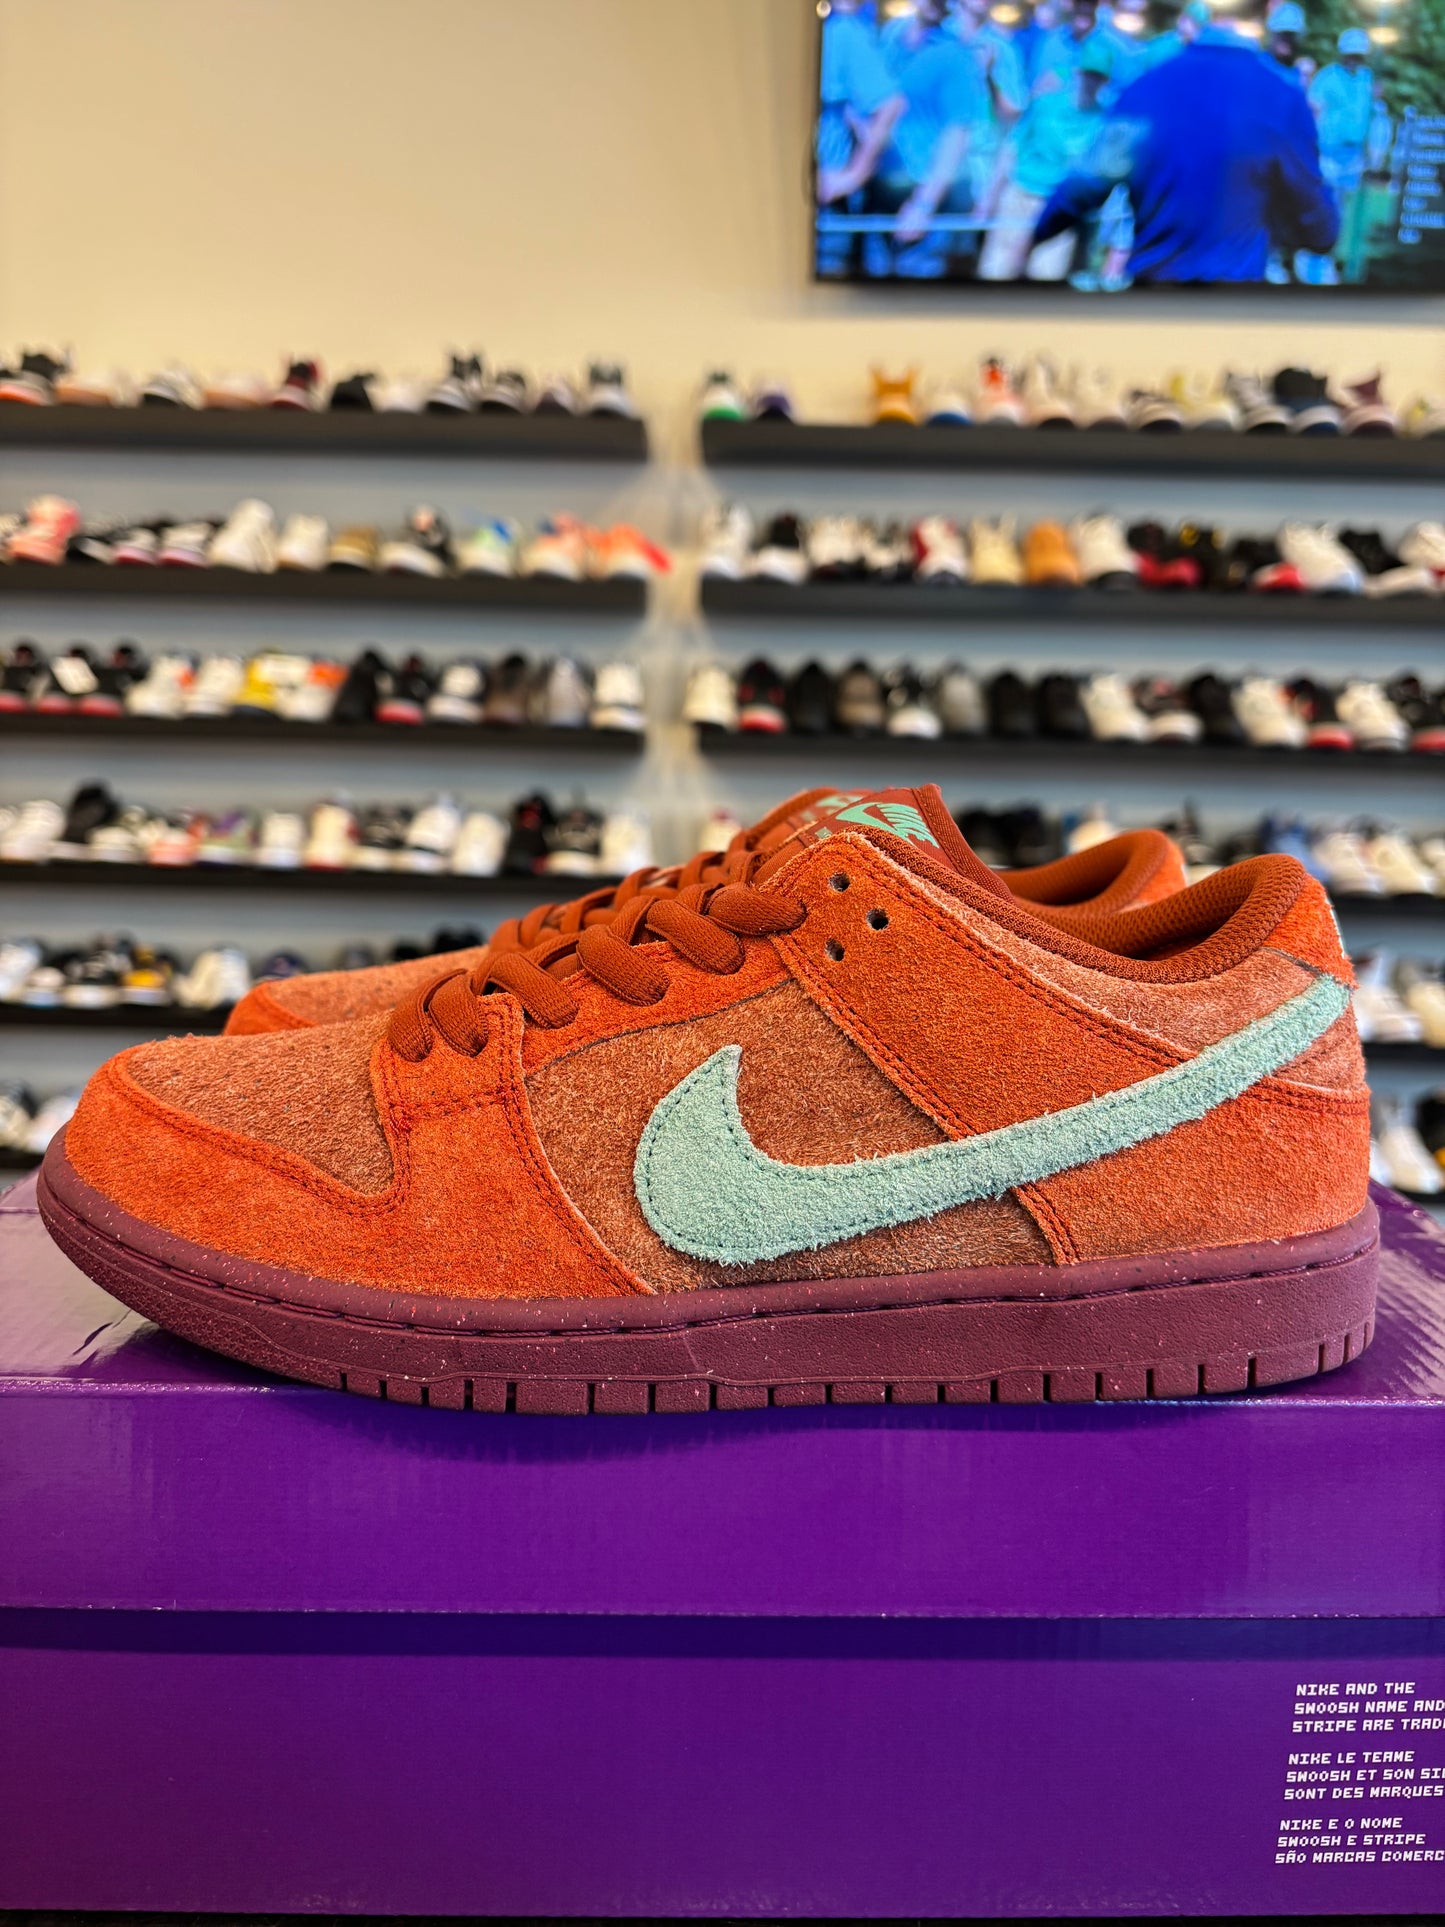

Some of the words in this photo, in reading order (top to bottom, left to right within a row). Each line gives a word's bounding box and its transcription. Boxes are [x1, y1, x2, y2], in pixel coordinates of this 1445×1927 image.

[1295, 1683, 1340, 1697] NIKE
[1345, 1682, 1378, 1696] AND
[1384, 1681, 1416, 1695] THE
[1293, 1701, 1360, 1715] SWOOSH
[1364, 1700, 1409, 1713] NAME
[1413, 1699, 1445, 1712] AND
[1292, 1719, 1357, 1733] STRIPE
[1362, 1718, 1395, 1732] ARE
[1400, 1717, 1445, 1731] TRAD
[1288, 1752, 1332, 1765] NIKE
[1337, 1751, 1357, 1764] LE
[1286, 1769, 1351, 1783] SWOOSH
[1356, 1769, 1378, 1781] ET
[1382, 1768, 1415, 1781] SON
[1283, 1787, 1327, 1800] SONT
[1331, 1786, 1365, 1799] DES
[1369, 1784, 1445, 1799] MARQUES
[1279, 1819, 1323, 1831] NIKE
[1327, 1818, 1339, 1830] E
[1344, 1818, 1355, 1830] O
[1360, 1817, 1403, 1829] NOME
[1277, 1835, 1342, 1848] SWOOSH
[1346, 1834, 1358, 1846] E
[1362, 1833, 1427, 1846] STRIPE
[1274, 1849, 1307, 1864] SÃO
[1312, 1851, 1377, 1864] MARCAS
